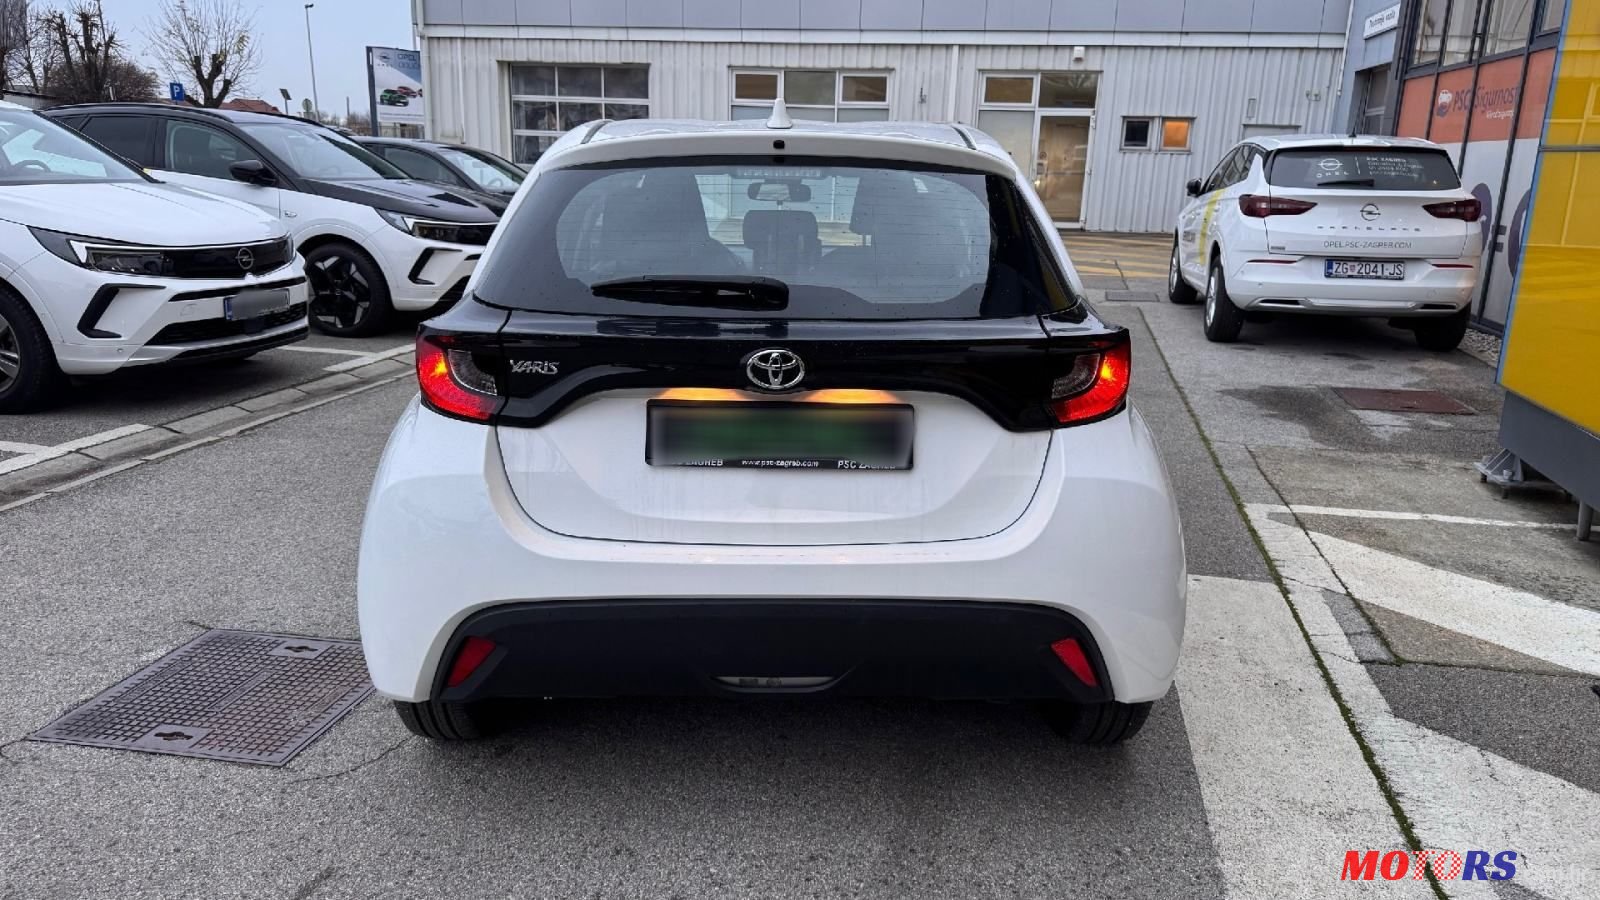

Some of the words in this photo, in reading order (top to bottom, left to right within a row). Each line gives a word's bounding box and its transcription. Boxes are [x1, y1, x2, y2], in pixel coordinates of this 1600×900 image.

[173, 85, 180, 97] P
[1334, 262, 1349, 274] ZG
[510, 359, 560, 375] YARIS
[741, 459, 819, 468] www.psc-zagreb.com
[837, 460, 857, 469] PSC
